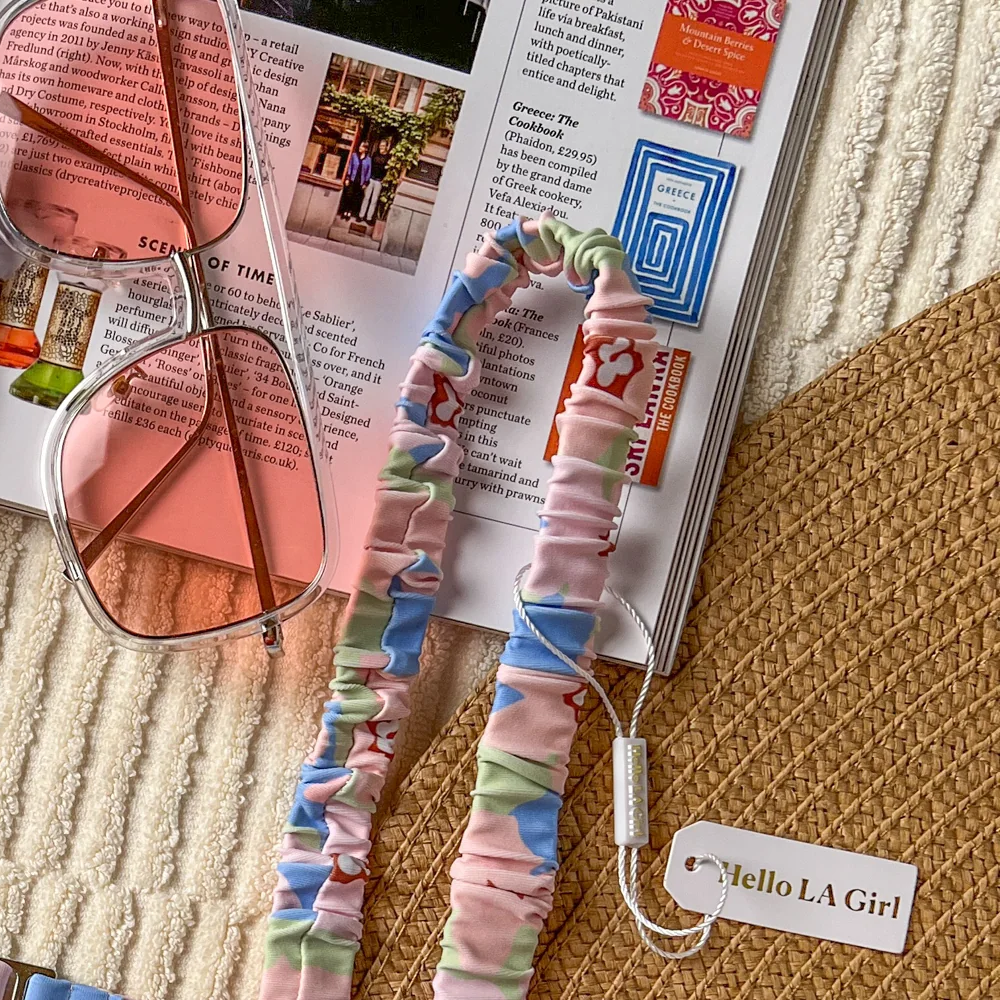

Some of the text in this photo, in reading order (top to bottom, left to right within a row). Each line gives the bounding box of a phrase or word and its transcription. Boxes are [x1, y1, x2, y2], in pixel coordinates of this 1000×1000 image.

[80, 21, 126, 39] founded
[111, 14, 156, 33] working
[538, 6, 625, 42] life via breakfast,
[594, 7, 644, 30] Pakistani
[10, 29, 135, 59] agency 2011 Jenny
[269, 41, 299, 55] retail
[534, 21, 624, 58] lunch and dinner,
[680, 23, 754, 52] Mountain Berries
[693, 38, 721, 54] Desert
[723, 48, 746, 61] Spice
[6, 40, 149, 76] Fredlund (right). Now, with
[259, 51, 304, 72] Creative
[531, 38, 611, 69] with poetically-
[2, 55, 139, 88] Mårskog woodworker
[263, 69, 298, 87] design
[526, 51, 625, 88] titled chapters that
[0, 68, 113, 98] has homeware
[522, 68, 616, 102] entice and delight.
[15, 86, 155, 126] Dry Costume, respectively.
[513, 101, 579, 128] Greece: The
[98, 116, 158, 142] Stockholm,
[509, 116, 564, 140] Cookbook
[109, 137, 164, 158] essentials.
[504, 130, 597, 166] (Phaidon, £29.95)
[500, 144, 598, 181] has been compiled
[505, 177, 582, 209] Greek cookery,
[529, 171, 592, 195] grand dame
[657, 184, 696, 201] GREECE
[207, 256, 275, 285] OF TIME
[115, 303, 167, 323] perfumer
[522, 308, 544, 322] The
[315, 329, 358, 347] scented
[513, 321, 559, 342] (Frances
[313, 342, 385, 370] Co for French
[497, 348, 535, 366] photos
[324, 362, 371, 382] over, and
[327, 392, 359, 409] Saint-
[656, 355, 687, 432] THE COOKBOOK
[108, 410, 182, 438] refills £36 each
[254, 405, 297, 425] sensory
[321, 406, 371, 428] Designed
[475, 403, 531, 425] punctuate
[465, 461, 540, 488] tamarind and
[499, 457, 522, 469] wait
[504, 489, 546, 504] prawns
[718, 861, 901, 919] Hello LA Girl
